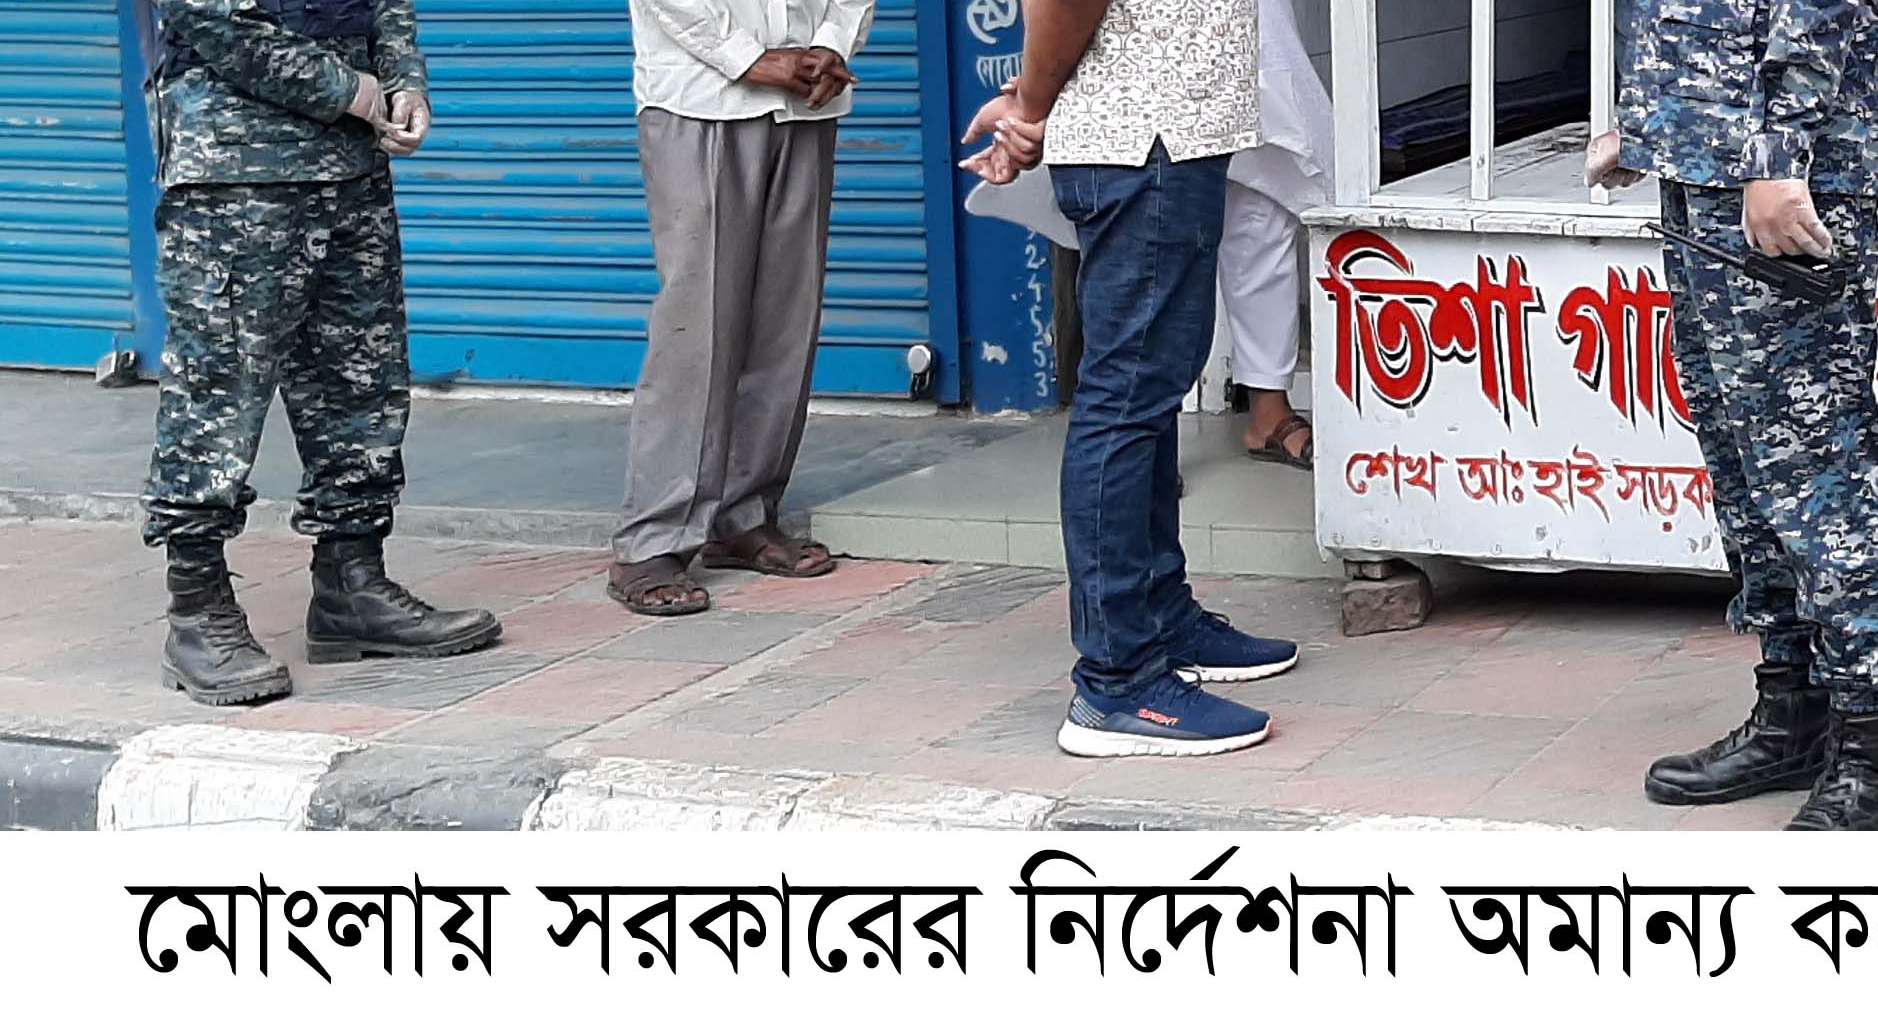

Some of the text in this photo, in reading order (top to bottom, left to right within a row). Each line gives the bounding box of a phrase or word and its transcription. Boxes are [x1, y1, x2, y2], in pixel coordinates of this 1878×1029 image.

[1316, 228, 1547, 433] তিশা
[1345, 444, 1448, 503] শেখ
[1455, 448, 1526, 507] আঃ
[1526, 443, 1613, 524] হাই
